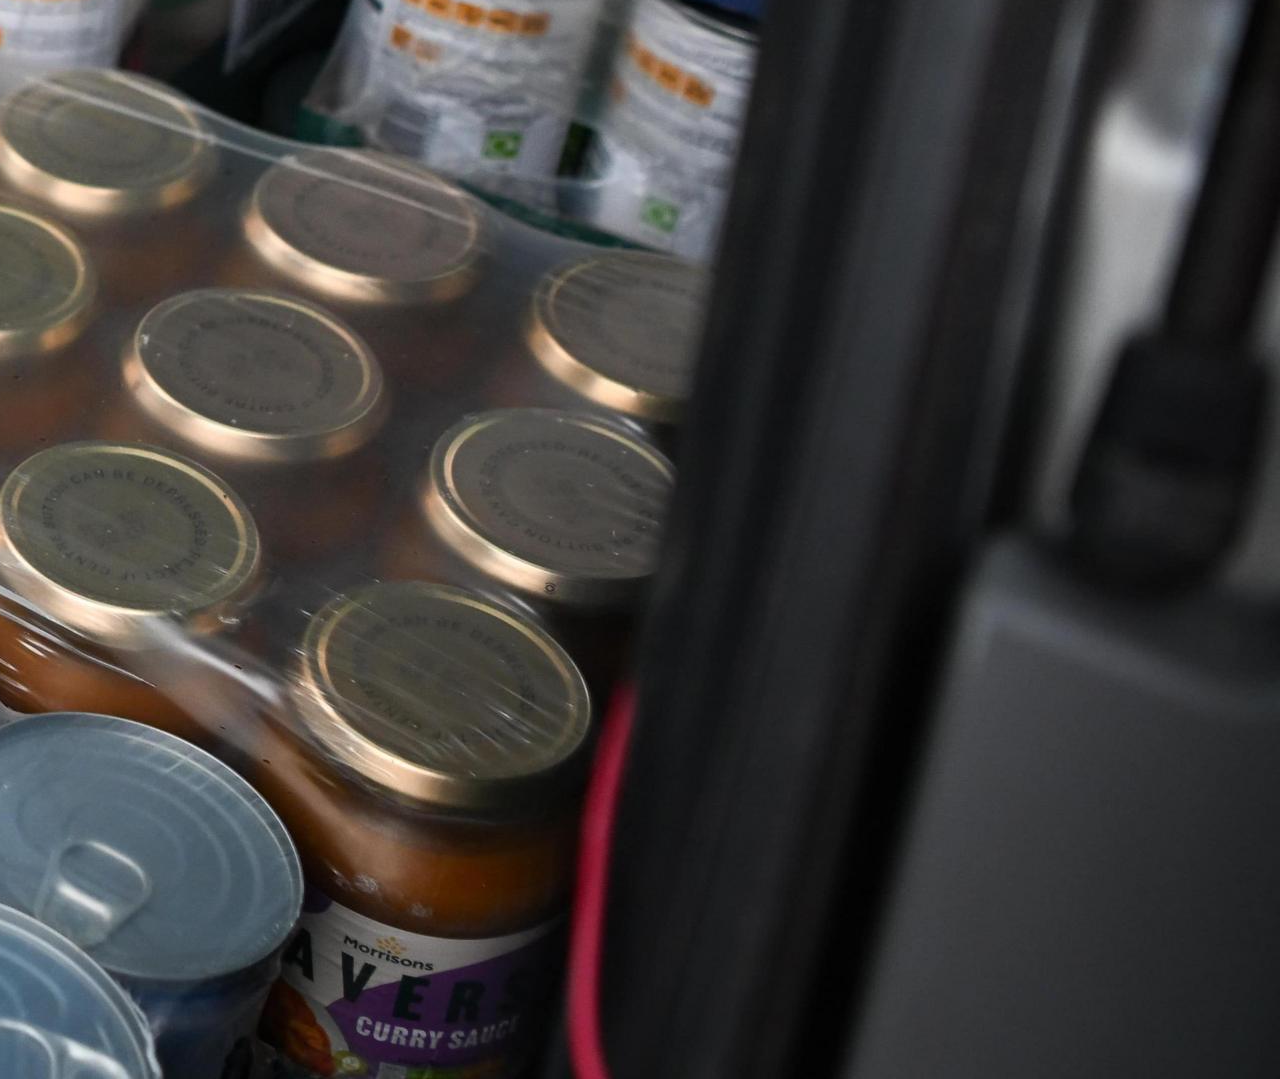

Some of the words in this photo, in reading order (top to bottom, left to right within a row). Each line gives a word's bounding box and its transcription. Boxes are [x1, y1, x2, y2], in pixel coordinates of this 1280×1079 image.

[70, 468, 106, 486] CAN
[113, 468, 136, 482] BE
[343, 934, 435, 972] Morrisons
[355, 1015, 444, 1050] CURRY
